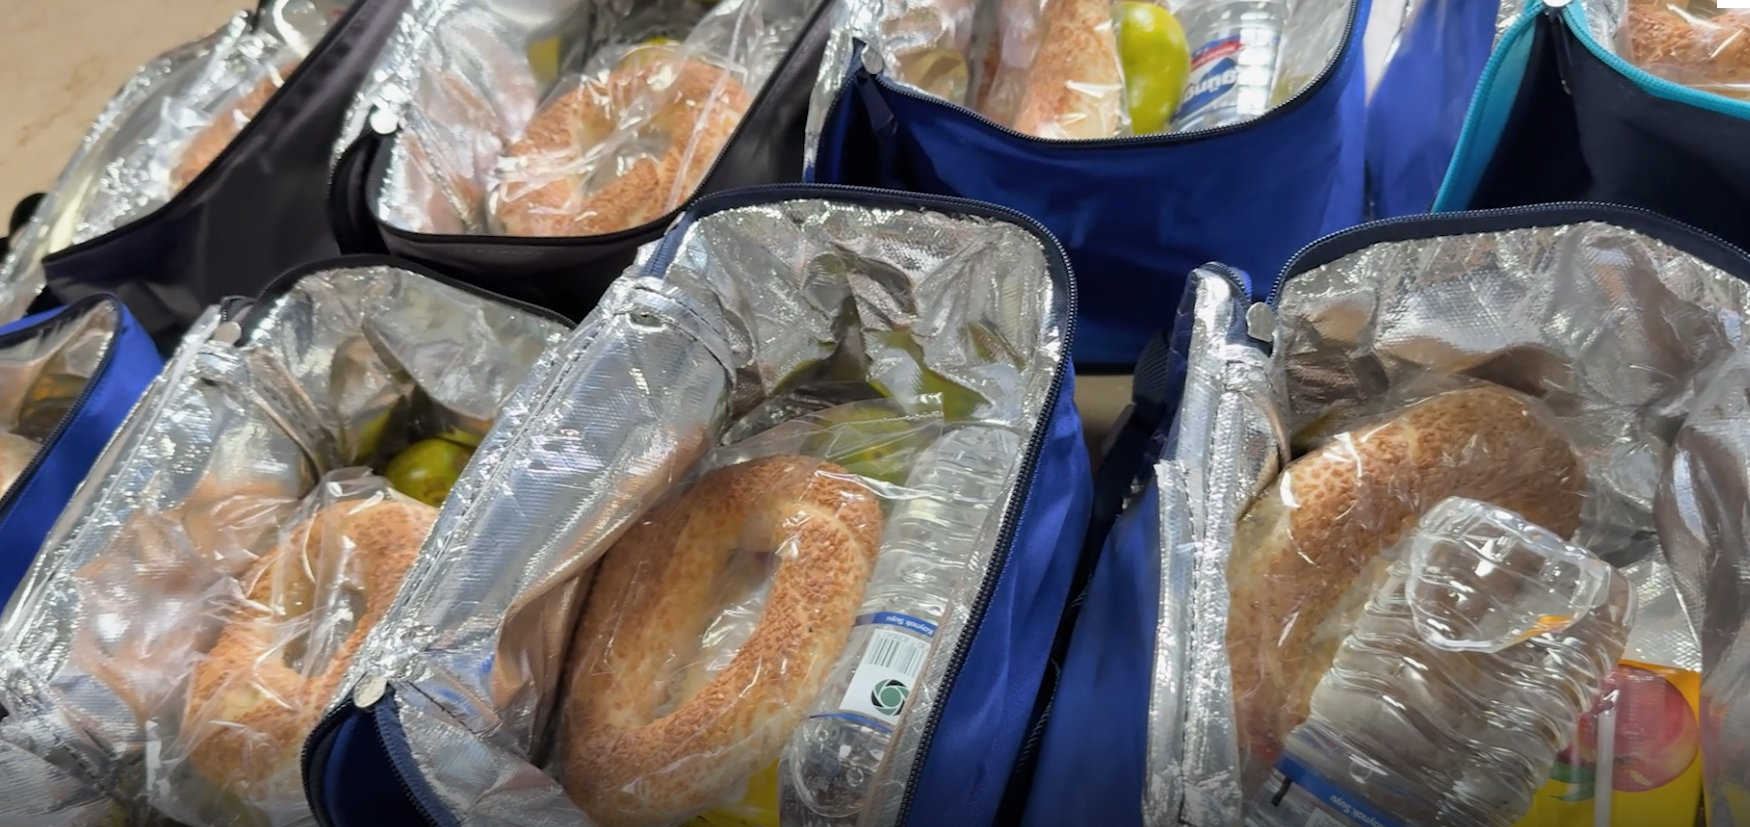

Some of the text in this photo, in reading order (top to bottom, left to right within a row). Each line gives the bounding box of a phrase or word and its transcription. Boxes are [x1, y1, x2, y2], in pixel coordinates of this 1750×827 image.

[886, 615, 935, 636] Kaynak Suyu
[1329, 795, 1352, 814] Suyu
[1351, 807, 1387, 827] aynak
